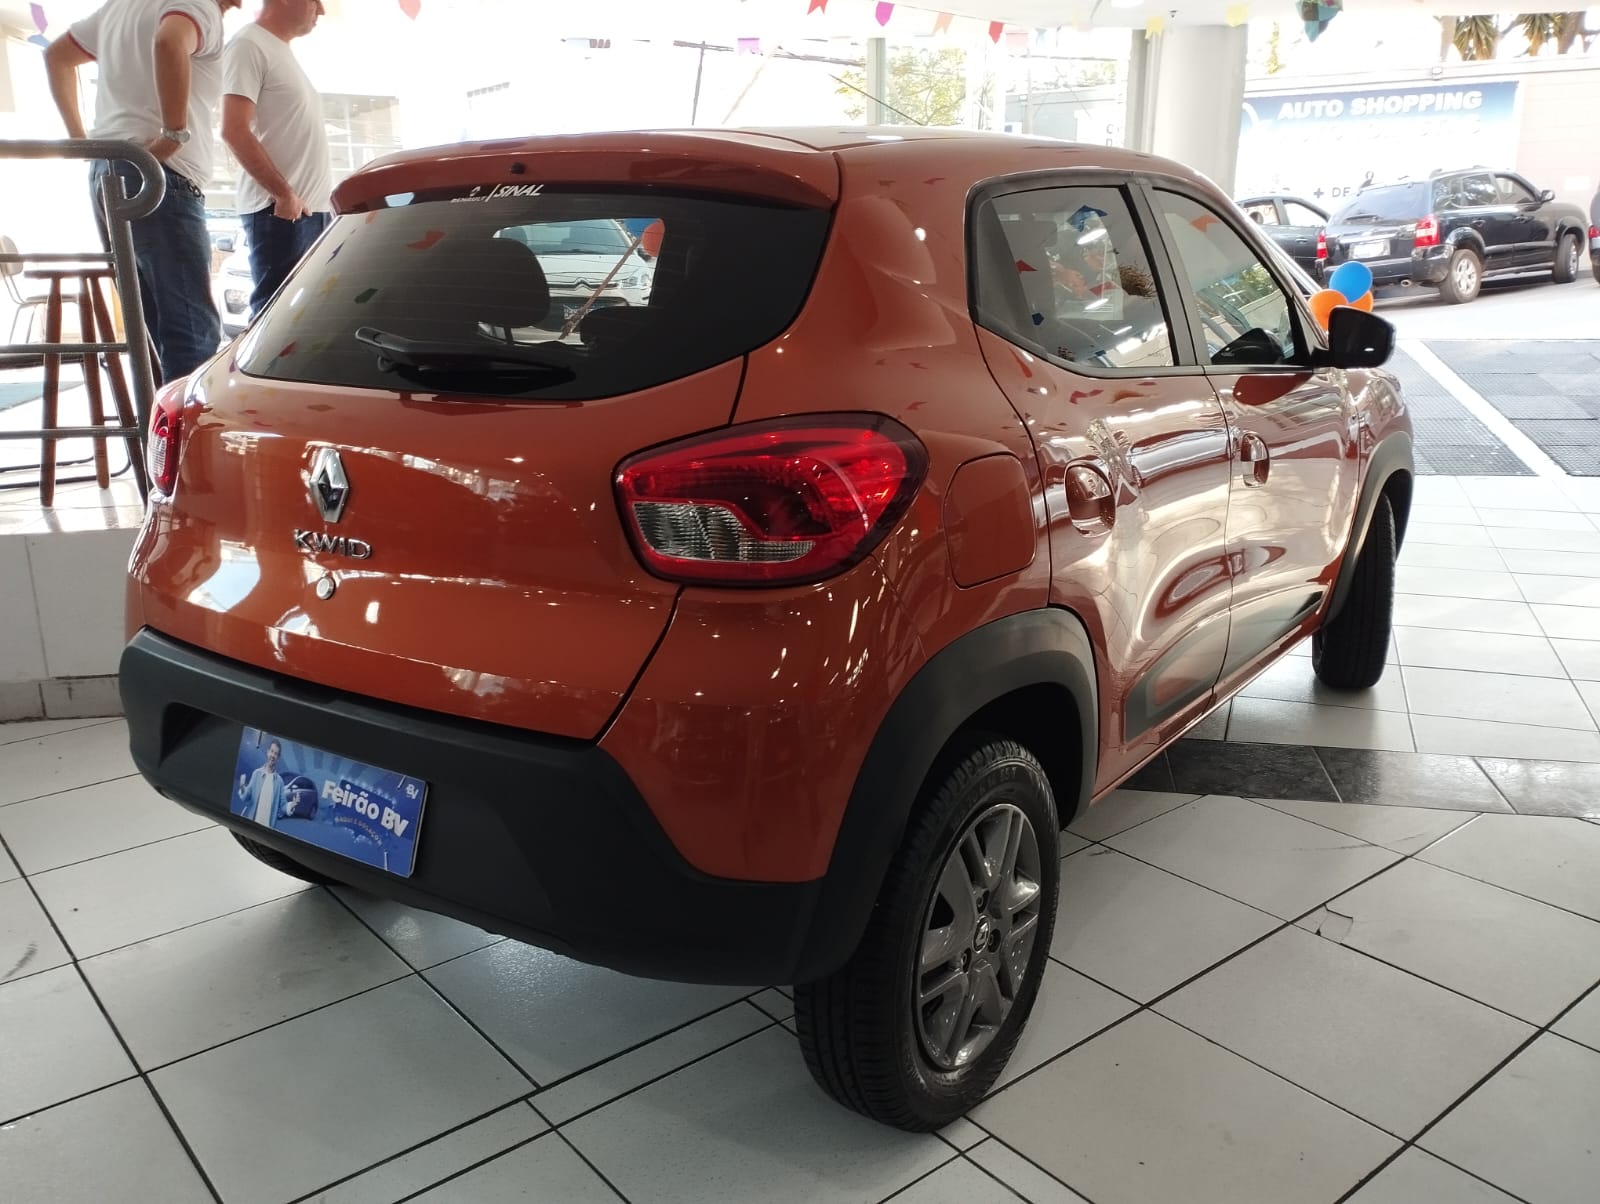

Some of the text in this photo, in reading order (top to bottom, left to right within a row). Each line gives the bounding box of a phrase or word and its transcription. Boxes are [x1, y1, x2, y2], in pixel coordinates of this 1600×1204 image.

[1277, 90, 1483, 120] AUTO SHOPPING
[493, 184, 544, 198] SINAL
[294, 528, 371, 560] KWID
[321, 780, 380, 821] Feirão
[380, 807, 409, 837] BV
